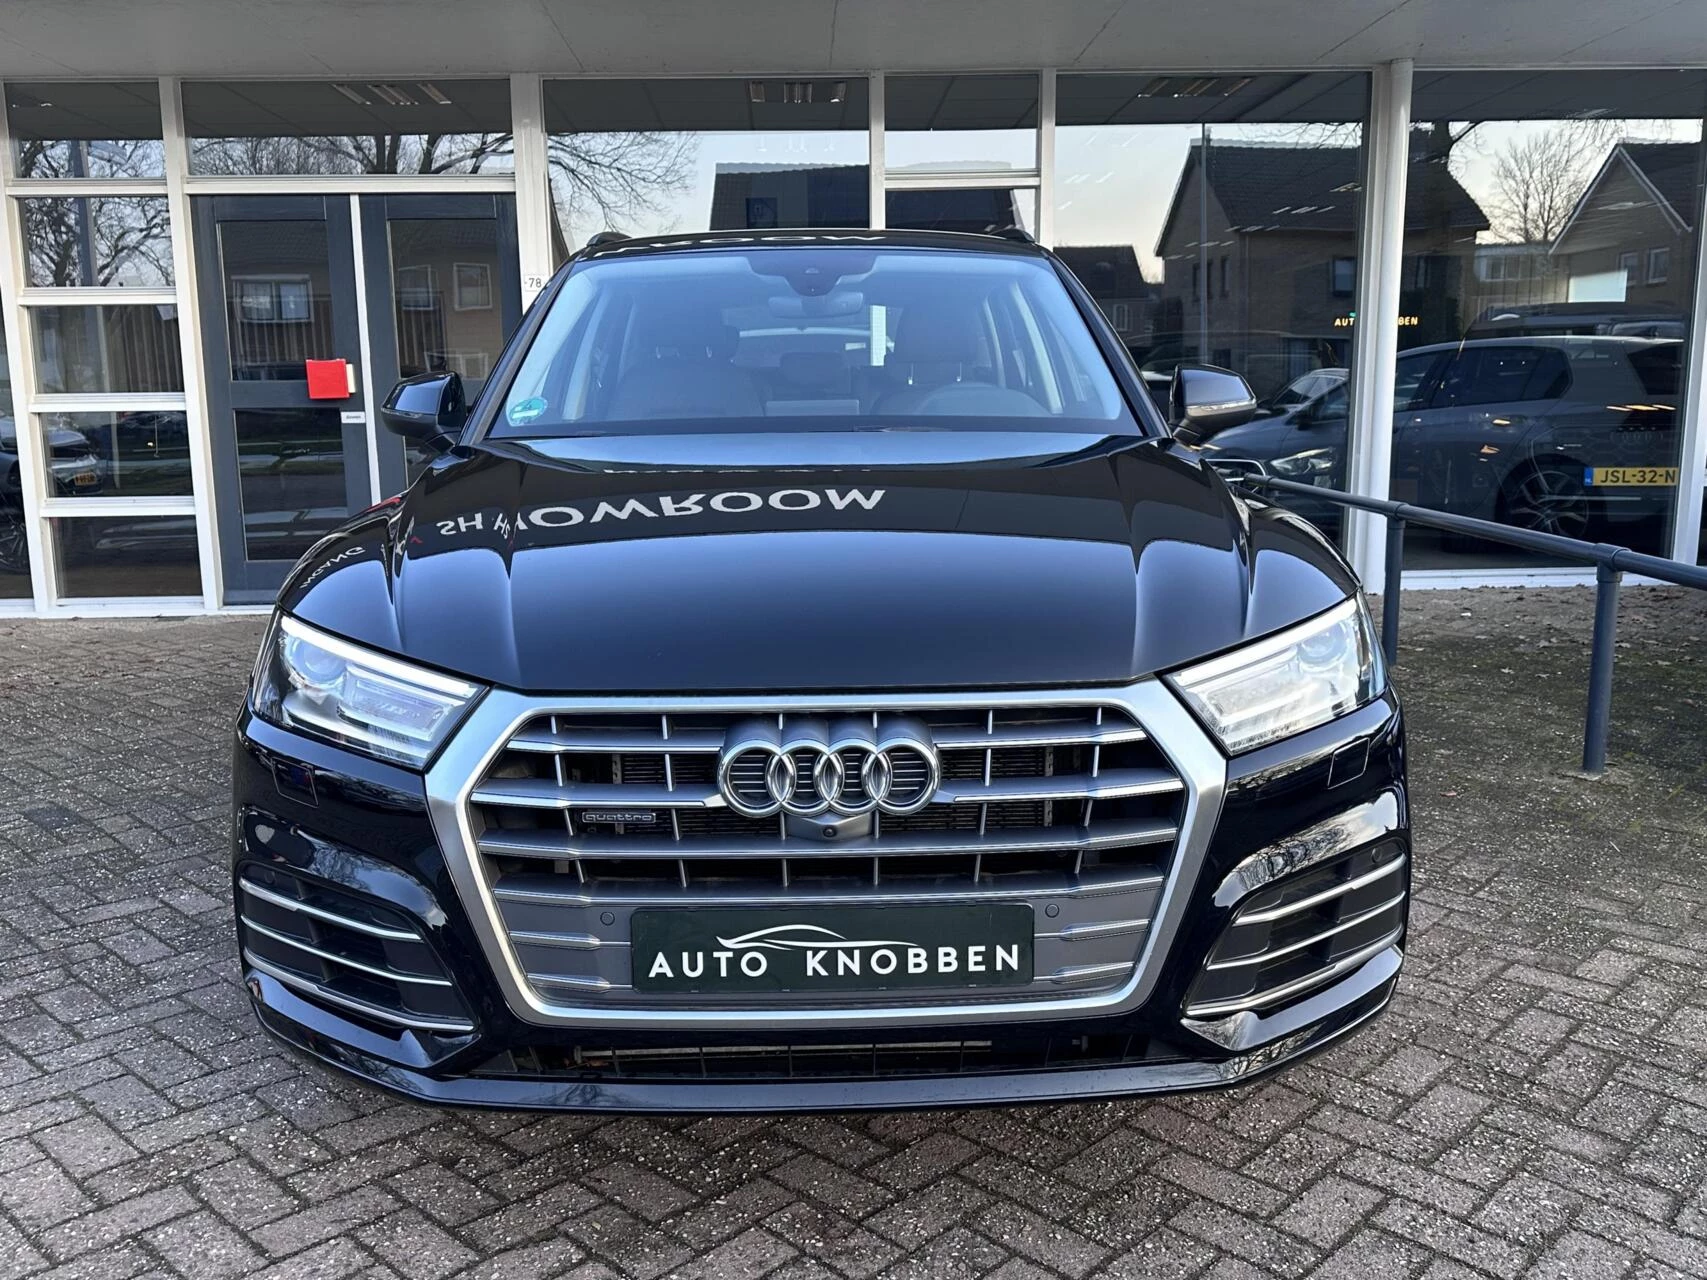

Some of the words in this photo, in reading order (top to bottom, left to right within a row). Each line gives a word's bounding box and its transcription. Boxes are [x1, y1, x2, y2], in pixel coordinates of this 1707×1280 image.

[528, 277, 542, 288] 78
[1334, 317, 1355, 326] AUT
[1600, 469, 1676, 484] JSL-32-N
[585, 813, 653, 823] quattro
[648, 951, 768, 978] AUTO
[806, 944, 1019, 977] KNOBBEN
